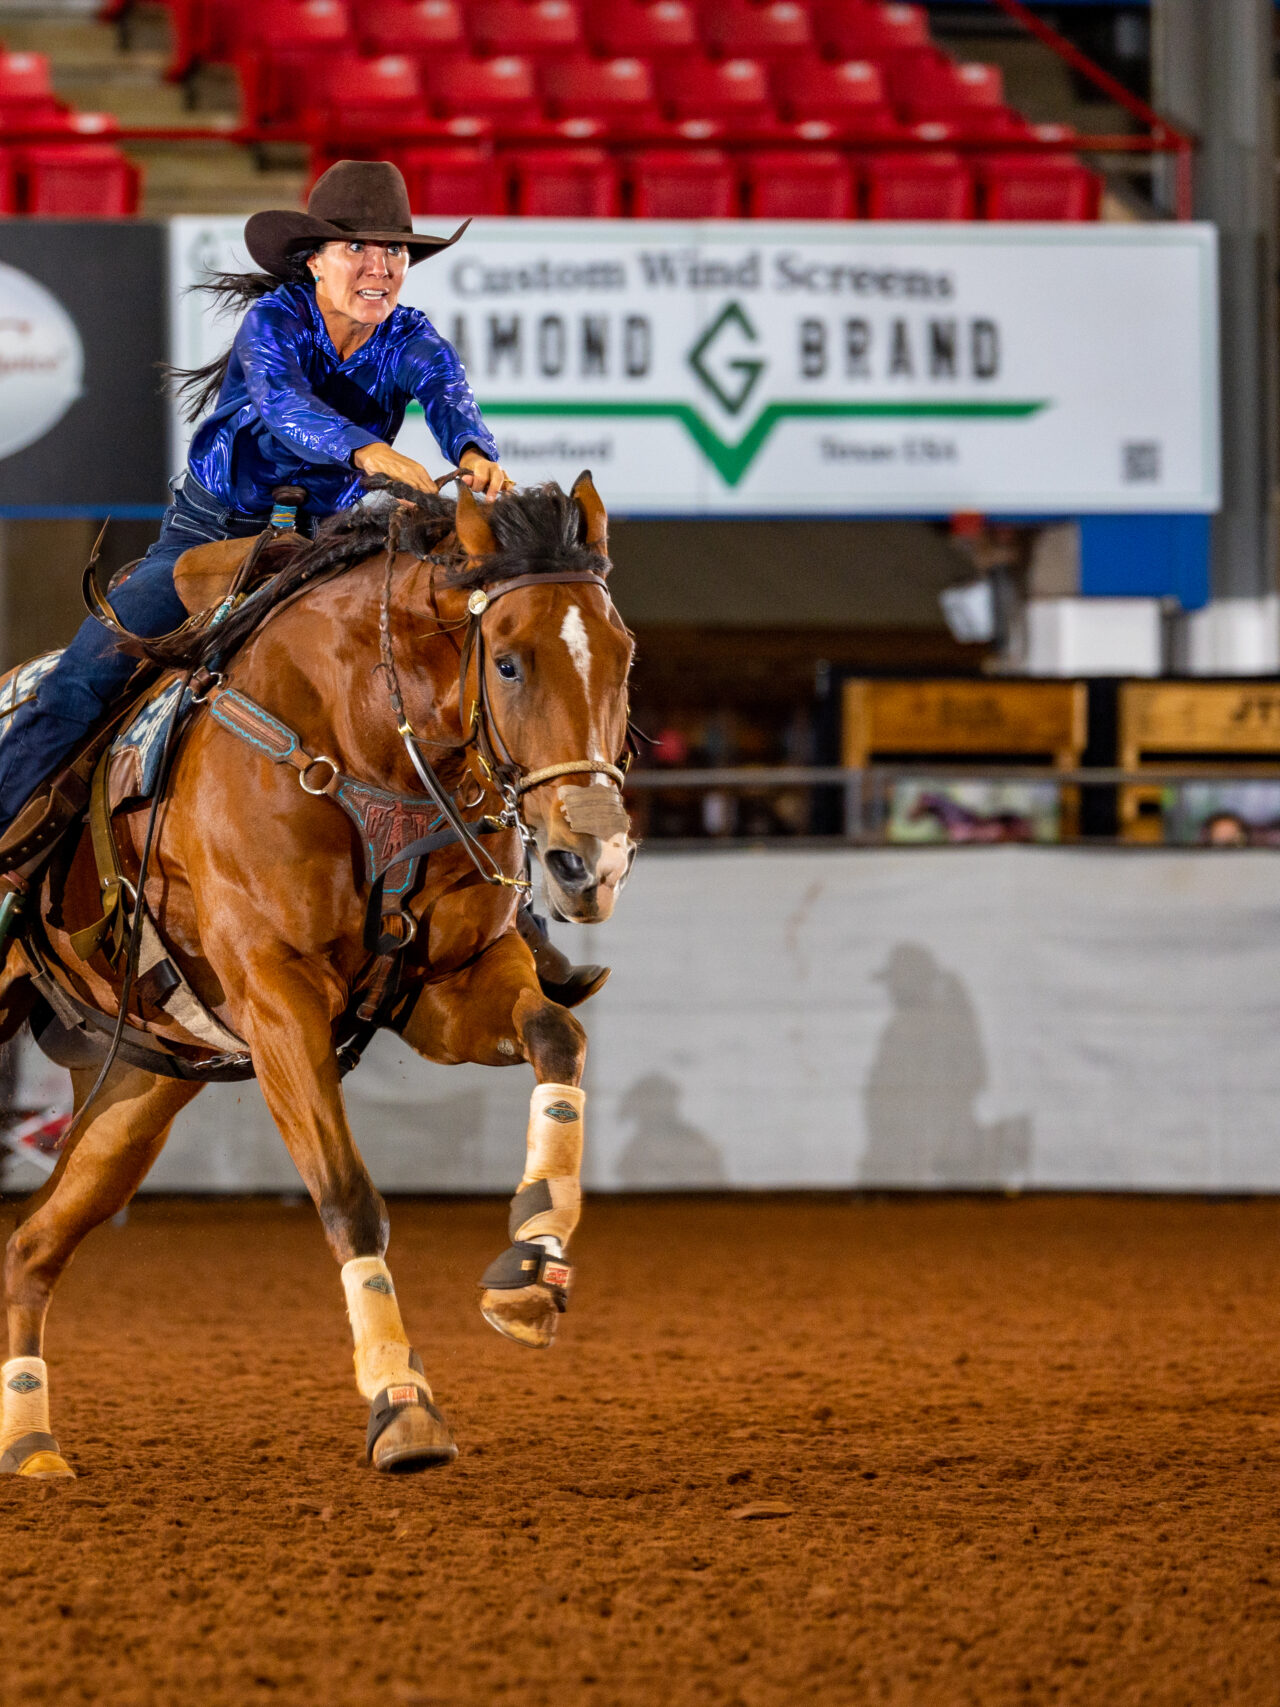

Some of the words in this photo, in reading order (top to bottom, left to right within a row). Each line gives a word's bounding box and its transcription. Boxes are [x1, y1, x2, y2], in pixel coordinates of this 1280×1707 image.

[450, 254, 629, 297] Custom
[636, 252, 762, 289] Wind
[775, 254, 957, 301] Screens
[449, 313, 653, 381] AMOND
[798, 316, 1002, 382] BRAND
